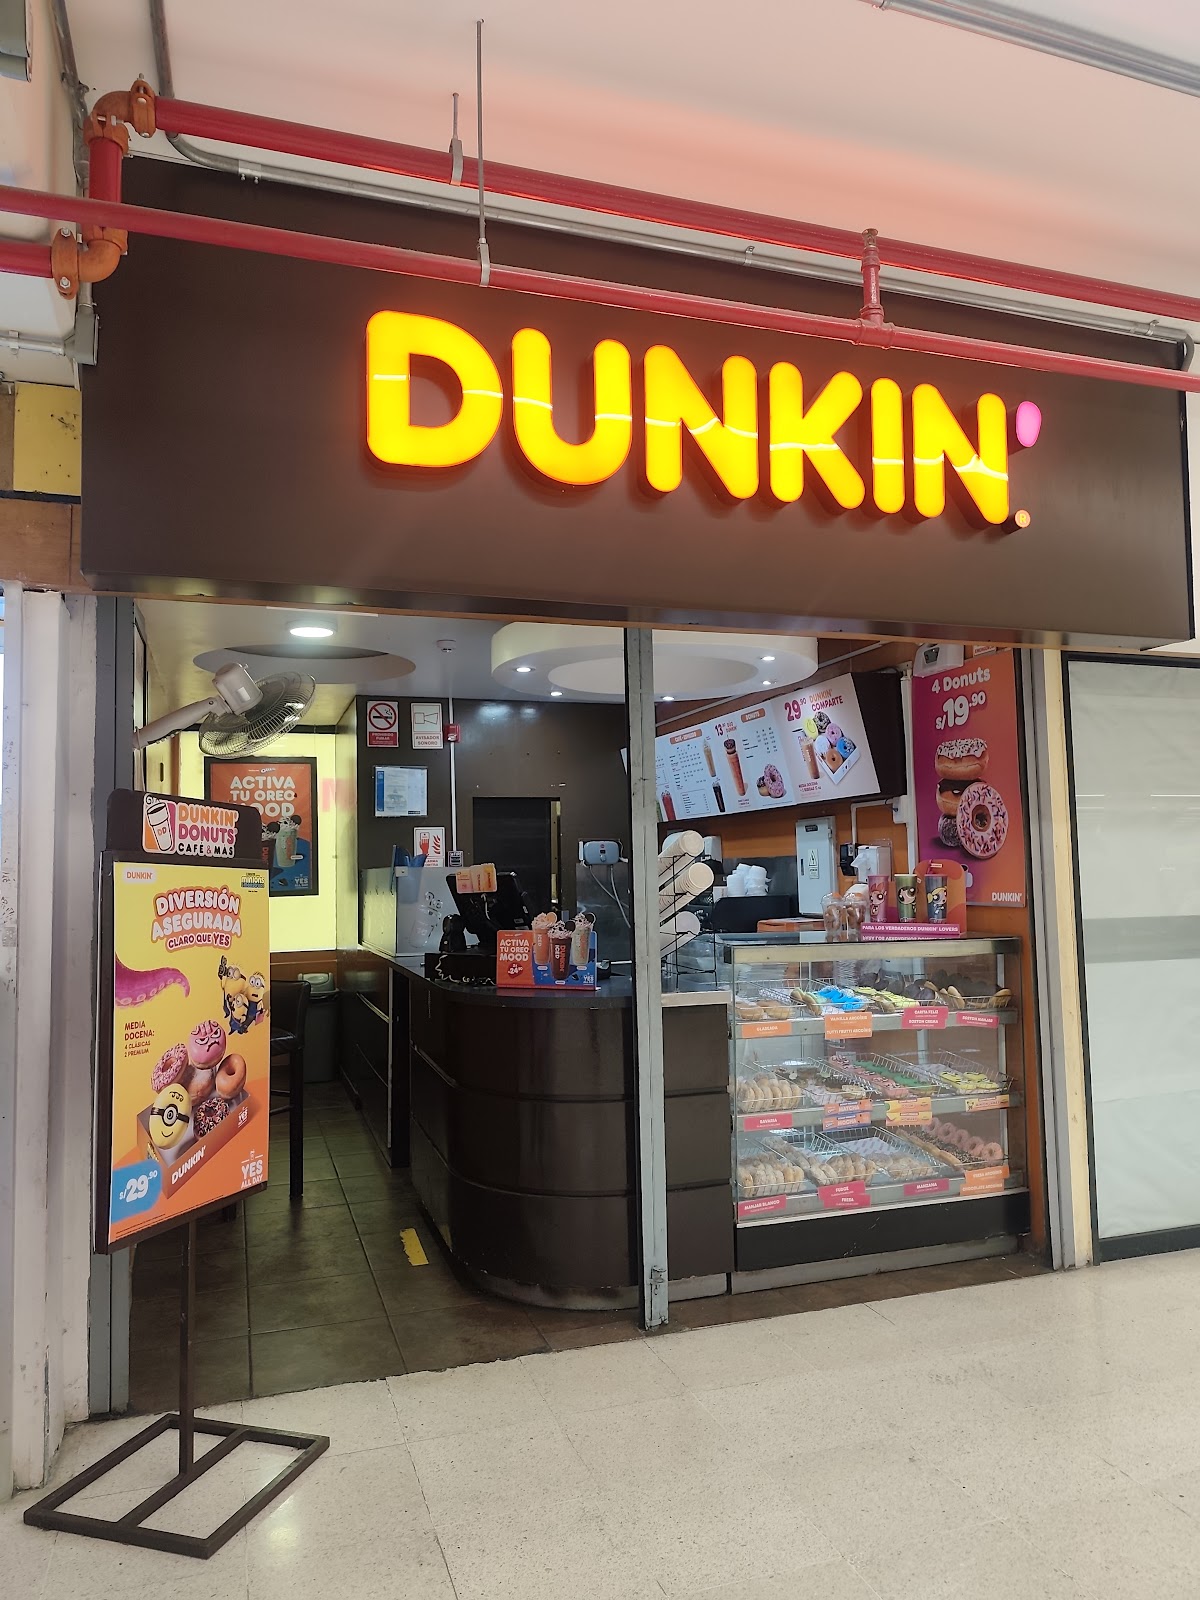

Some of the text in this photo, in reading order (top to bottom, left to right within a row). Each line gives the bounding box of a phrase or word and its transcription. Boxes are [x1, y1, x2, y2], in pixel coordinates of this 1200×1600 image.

[367, 310, 1042, 524] DUNKIN'
[932, 667, 991, 694] 4 Donuts
[811, 695, 844, 712] COMPARTE
[230, 775, 296, 790] ACTIVA
[230, 790, 295, 801] TU OREO
[178, 804, 238, 828] DUNKIN'
[157, 826, 167, 836] DD
[178, 823, 235, 845] DONUTS
[178, 842, 234, 856] CAFÉ & MÁS
[126, 871, 153, 879] DUNKIN'
[156, 889, 240, 916] DIVERSIÓN
[991, 891, 1022, 902] DUNKIN'
[152, 912, 242, 941] ASEGURADA
[168, 932, 230, 949] CLARO QUE YES
[500, 953, 529, 961] MOOD
[124, 1020, 146, 1030] MEDIA
[124, 1029, 155, 1041] DOCENA:
[838, 1104, 859, 1112] MATCHA
[171, 1145, 206, 1184] DUNKIN'
[242, 1159, 263, 1180] YES
[241, 1174, 263, 1189] ALL DAY
